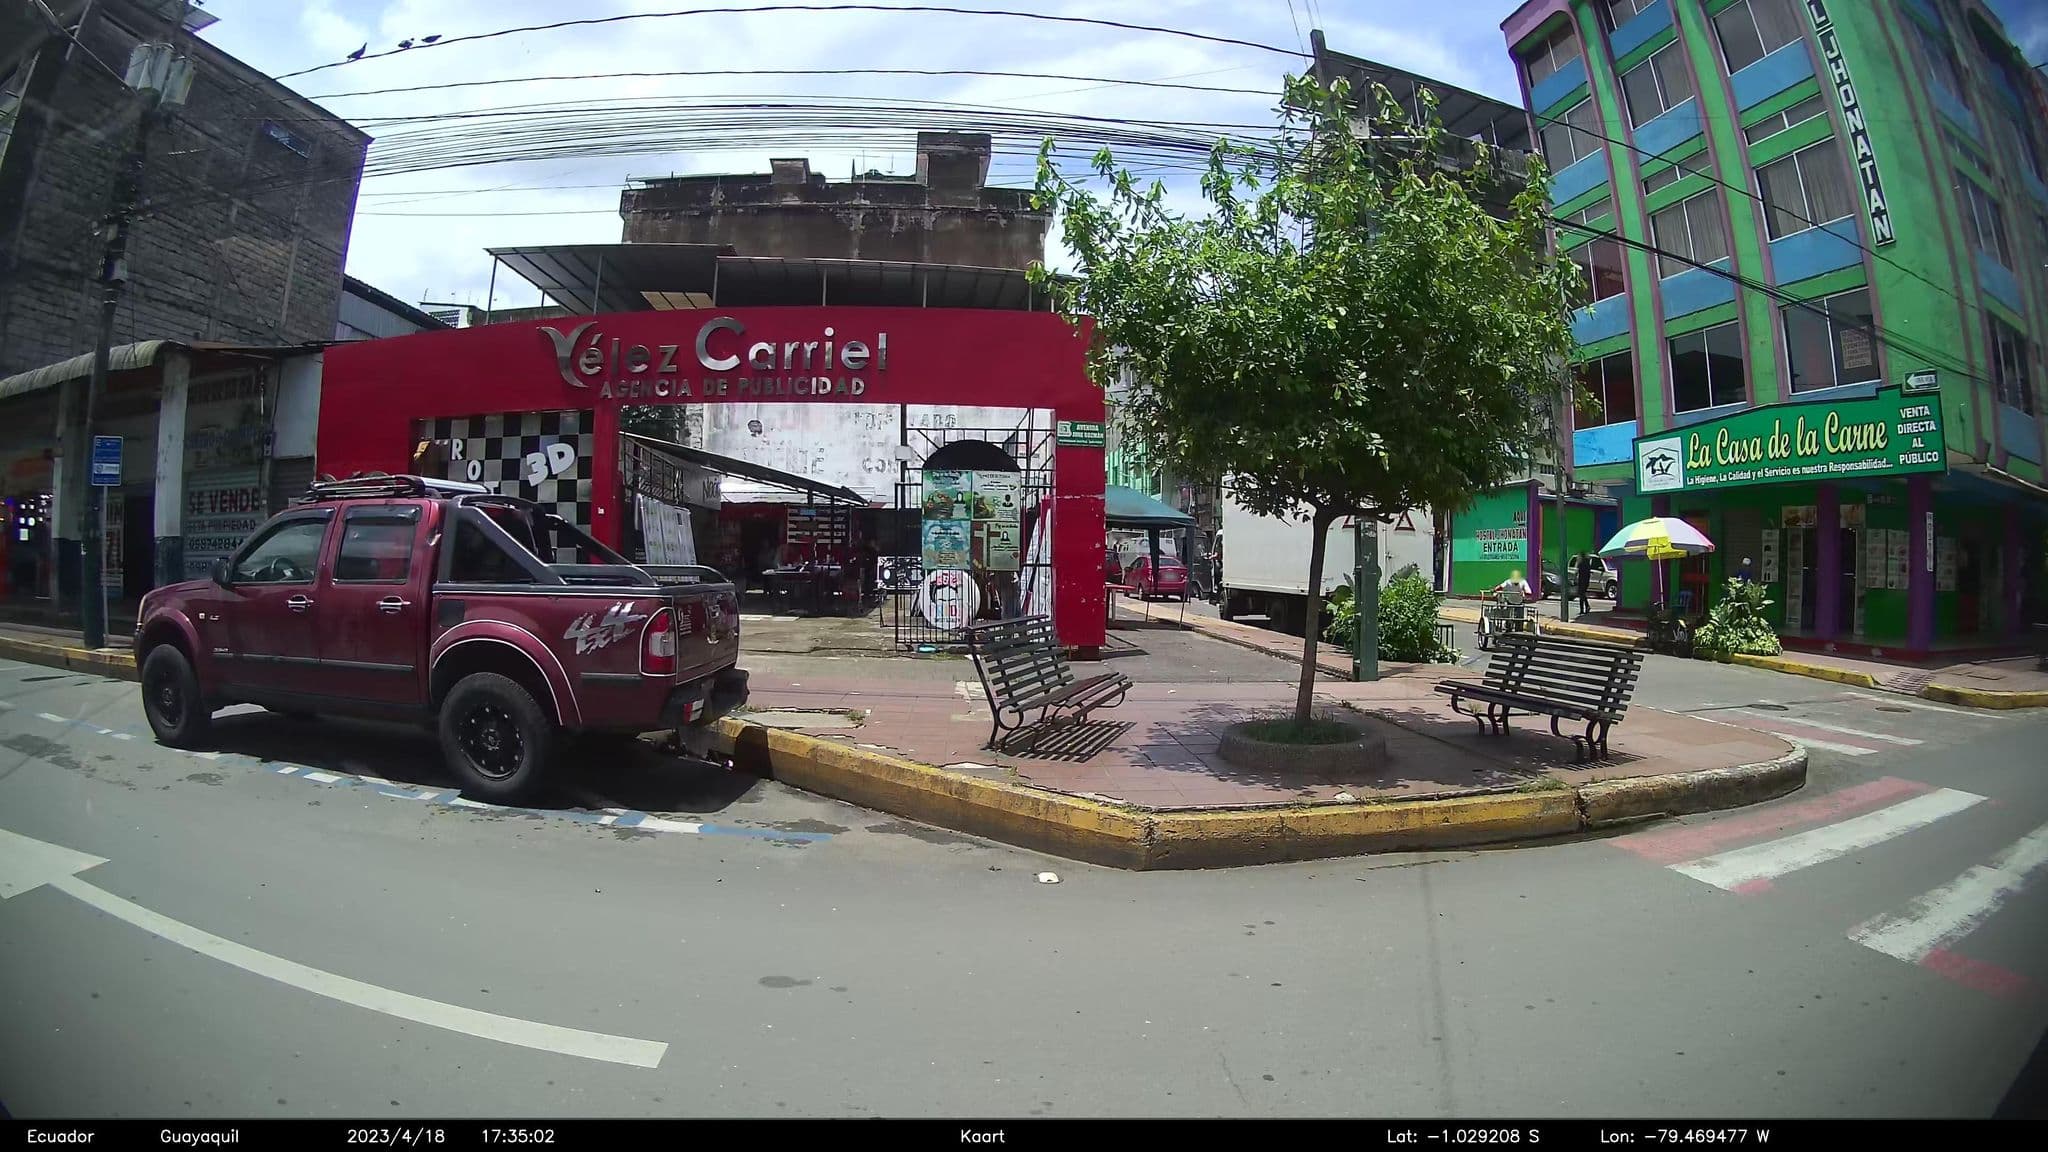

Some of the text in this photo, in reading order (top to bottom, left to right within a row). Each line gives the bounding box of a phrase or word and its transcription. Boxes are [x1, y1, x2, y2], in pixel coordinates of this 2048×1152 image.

[1825, 35, 1891, 242] JHONATAN
[536, 316, 888, 388] Vélez Carriel
[601, 376, 865, 398] AGENCIA DE PUBLICIDAD
[1900, 405, 1931, 419] VENTA
[1897, 420, 1937, 435] DIRECTA
[1687, 411, 1888, 469] La Casa de la Carne
[1912, 438, 1925, 448] AL
[526, 442, 576, 487] 3D
[1899, 451, 1939, 465] PÚBLICO
[1686, 476, 1695, 485] La
[1720, 473, 1727, 482] La
[1728, 469, 1751, 481] Calidad
[1764, 465, 1791, 477] Servicio
[1792, 467, 1801, 475] es
[1802, 463, 1828, 474] nuestra
[1483, 542, 1519, 552] ENTRADA
